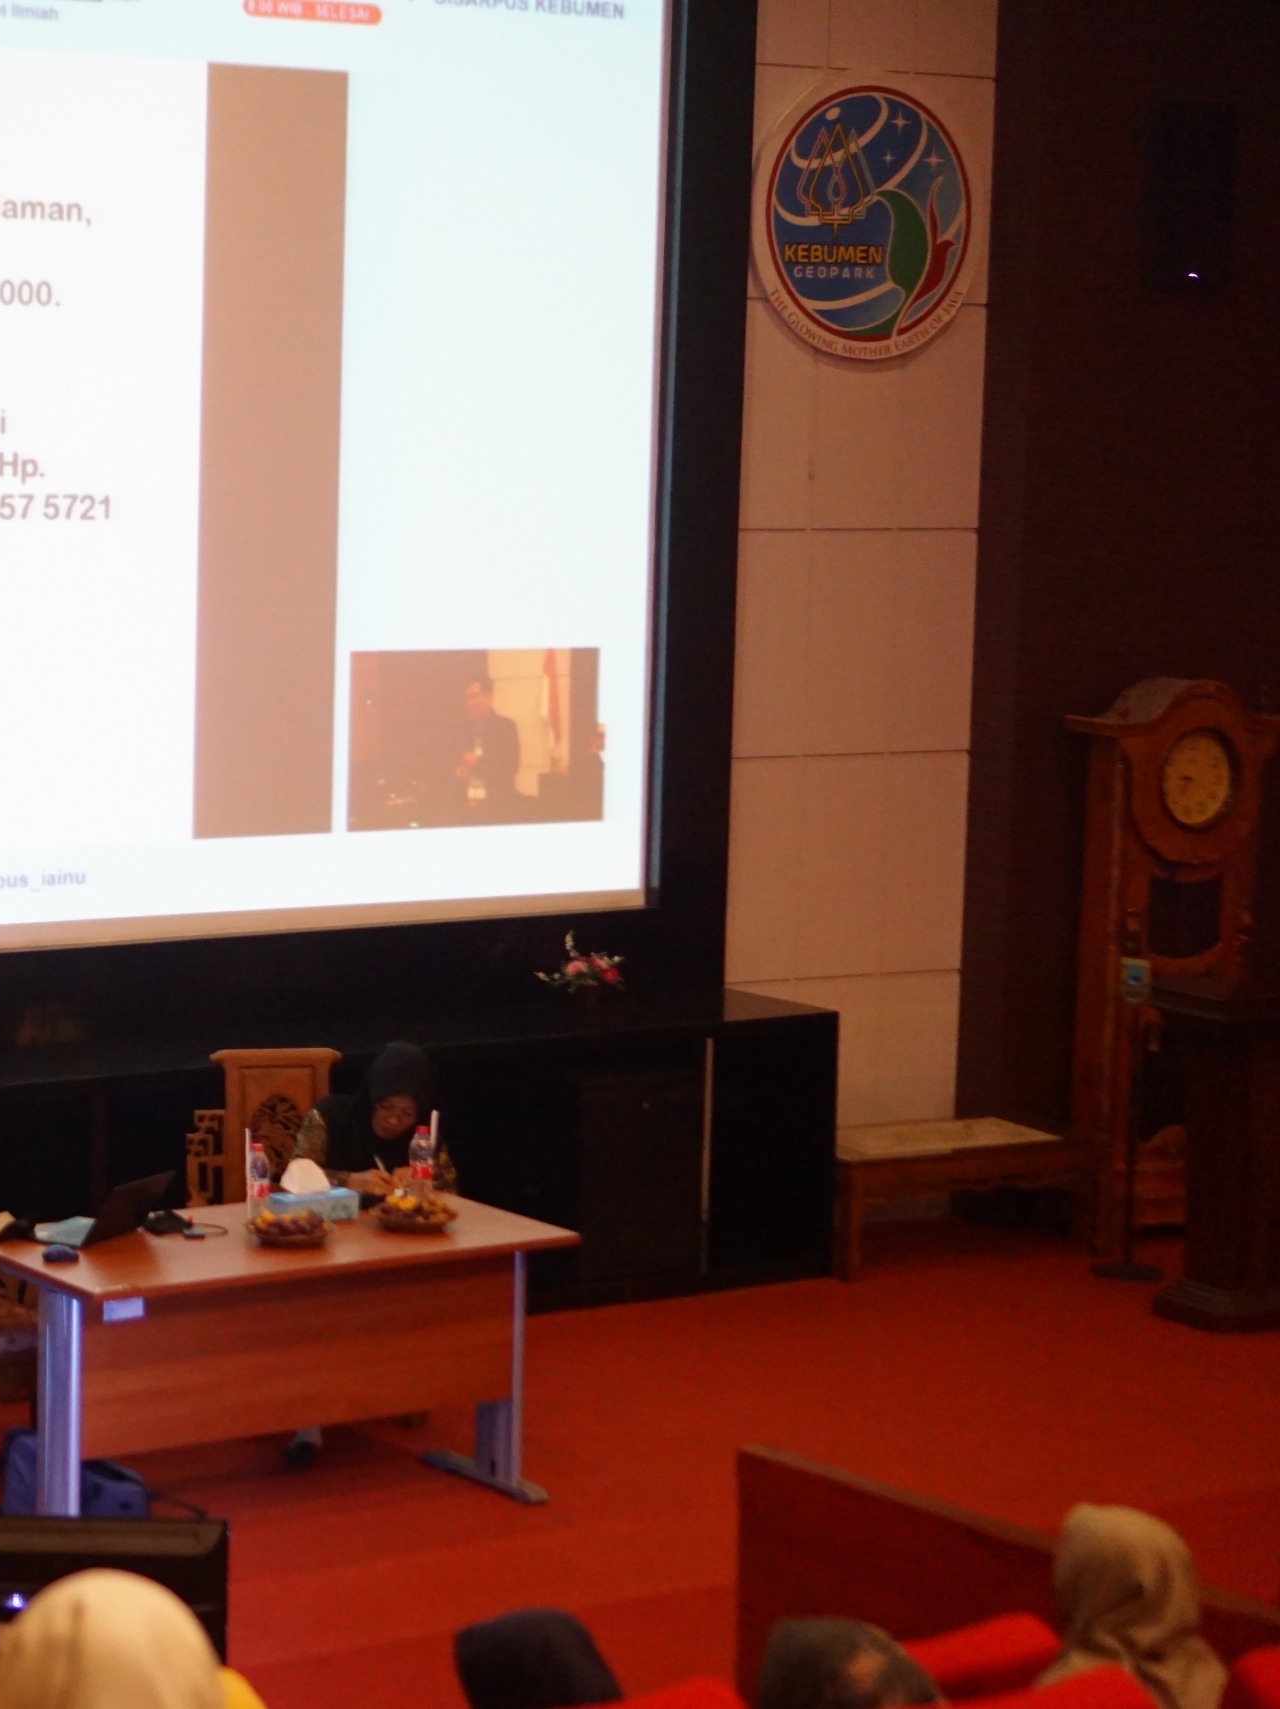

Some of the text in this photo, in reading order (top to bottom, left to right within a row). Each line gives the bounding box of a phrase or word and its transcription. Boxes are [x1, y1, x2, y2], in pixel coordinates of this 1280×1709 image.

[11, 3, 58, 20] Ilmiah
[535, 0, 624, 19] KEBUMEN
[784, 243, 883, 264] KEBUMEN
[793, 265, 875, 279] GEOPARK
[770, 288, 789, 313] THE
[787, 312, 838, 352] GLOWING
[842, 343, 890, 357] MOTHER
[43, 494, 111, 521] 5721
